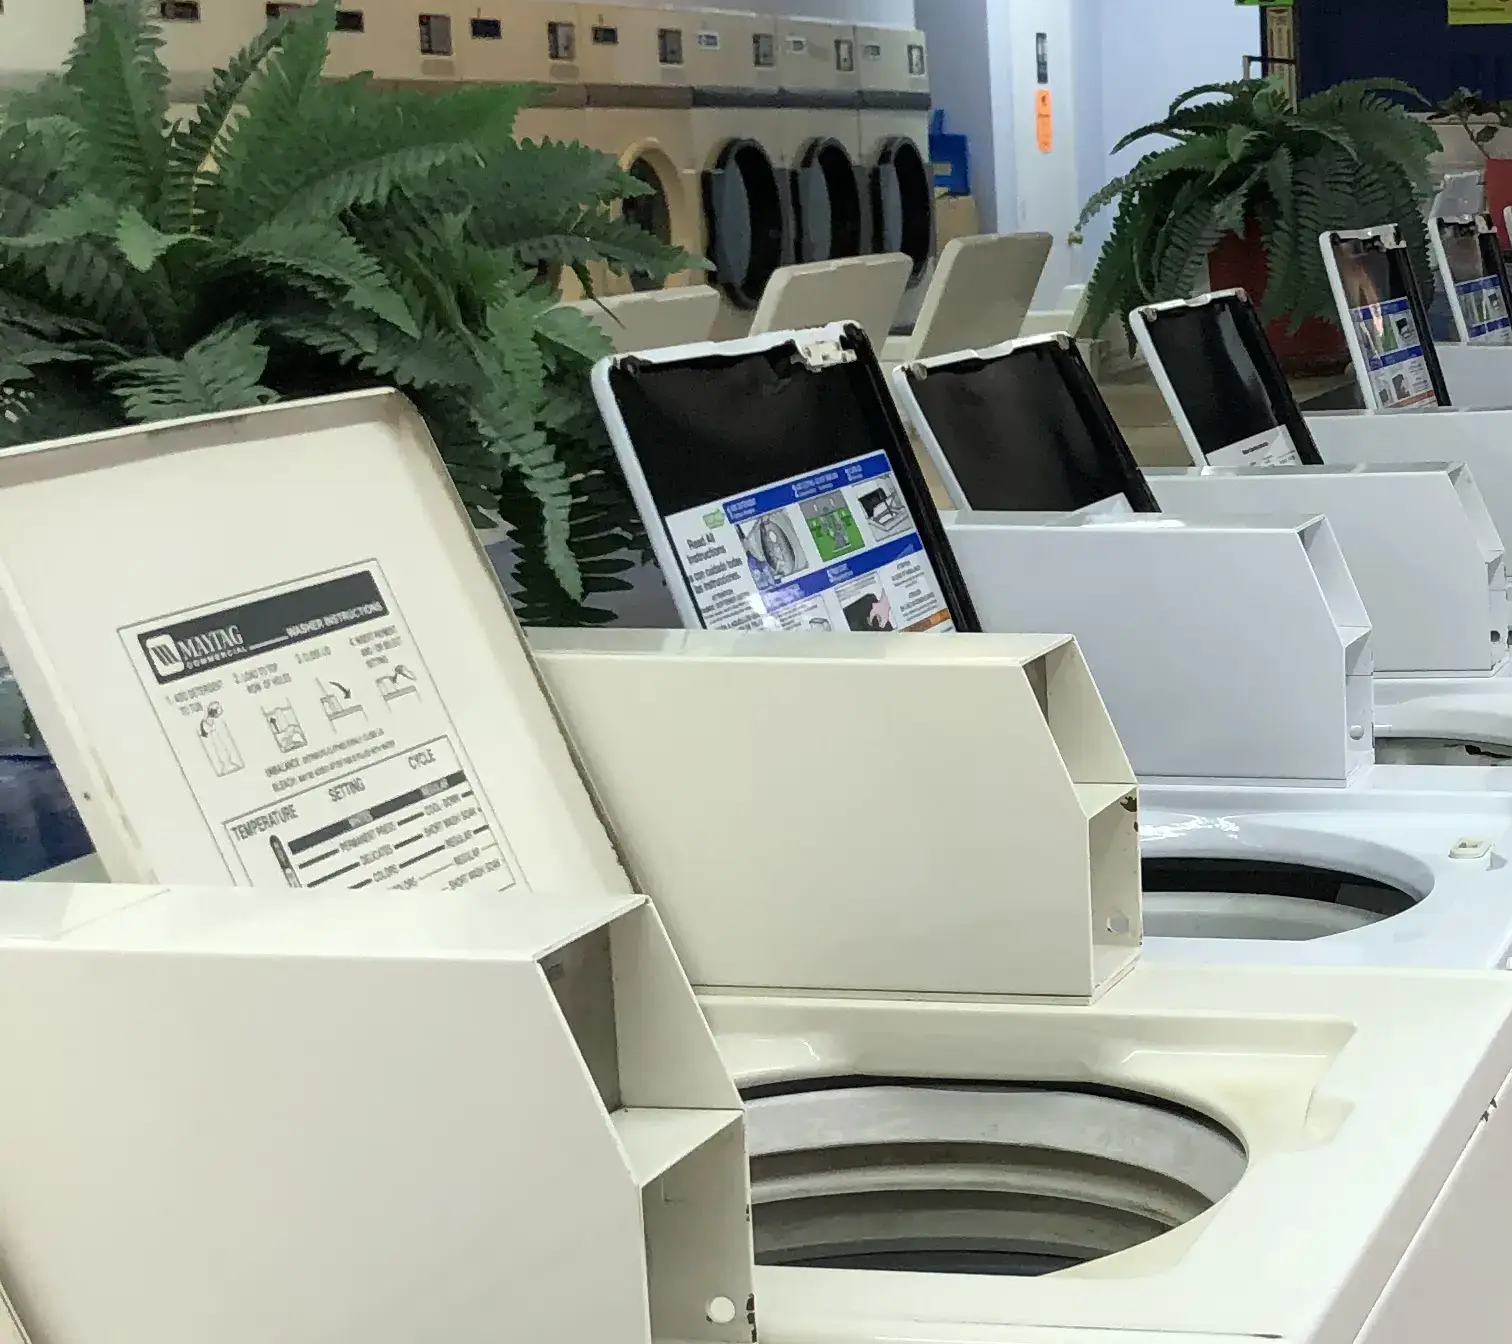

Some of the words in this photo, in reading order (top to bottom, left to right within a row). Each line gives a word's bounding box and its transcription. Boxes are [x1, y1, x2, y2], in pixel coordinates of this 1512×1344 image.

[178, 625, 244, 661] MAYTAG
[408, 749, 436, 769] CYCLE
[328, 777, 365, 802] SETTING
[230, 804, 299, 841] TEMPERATURE
